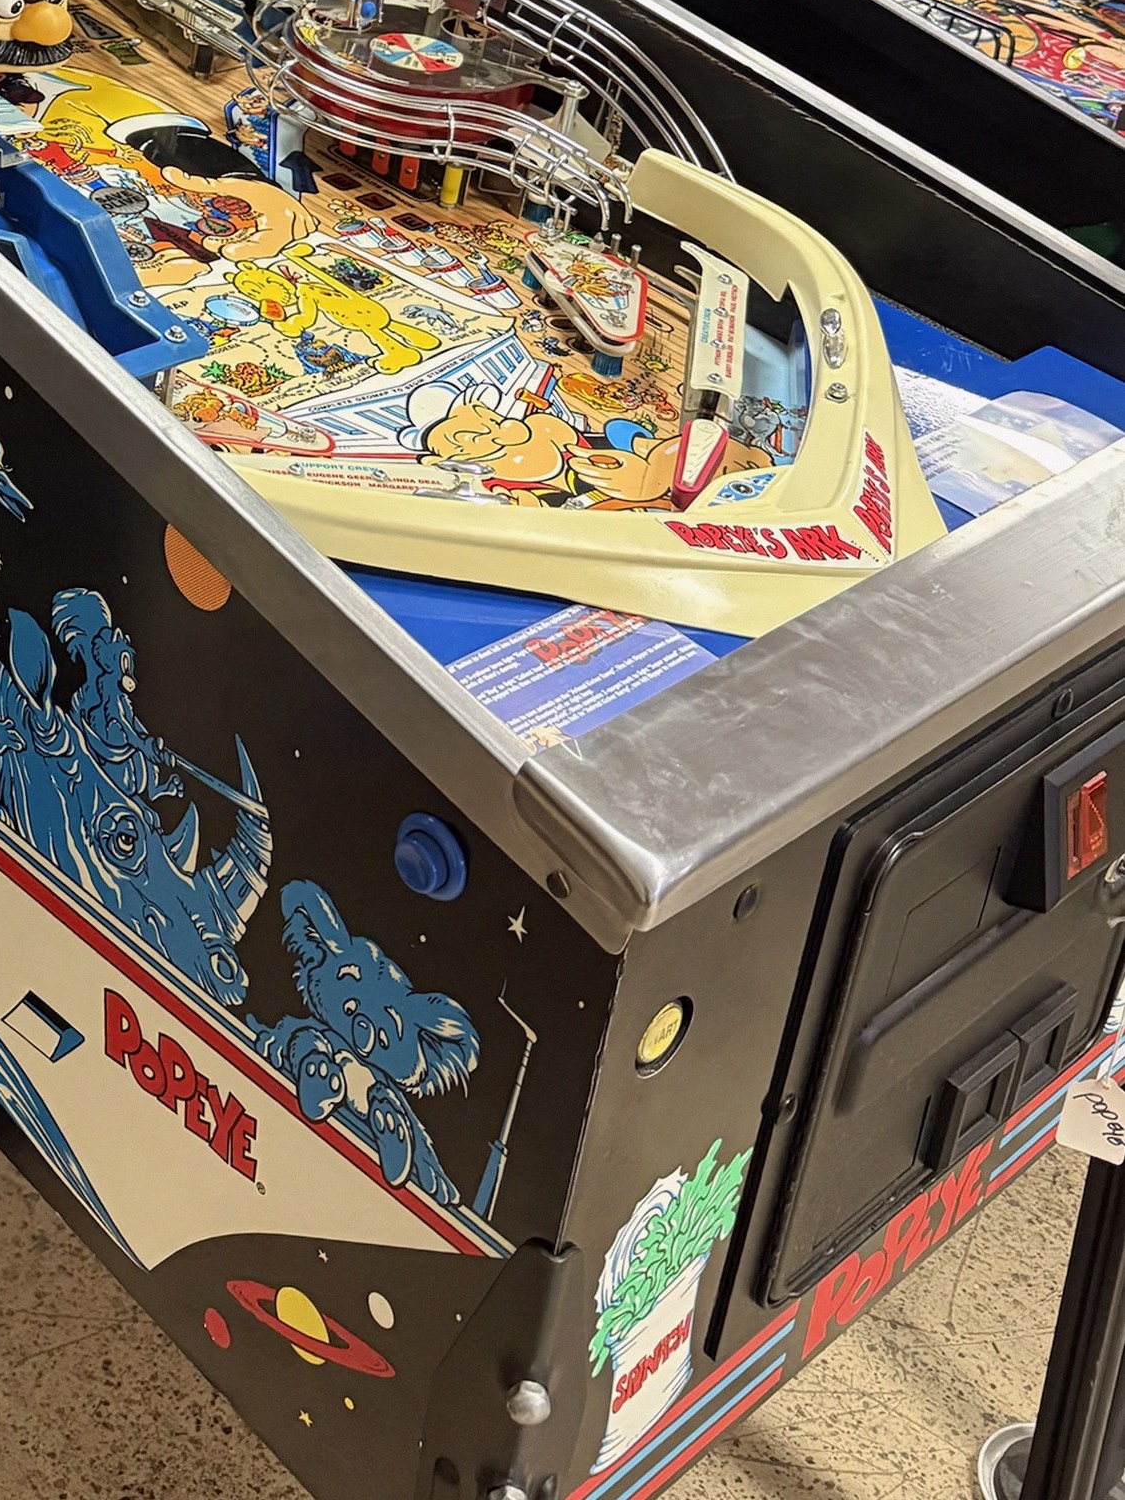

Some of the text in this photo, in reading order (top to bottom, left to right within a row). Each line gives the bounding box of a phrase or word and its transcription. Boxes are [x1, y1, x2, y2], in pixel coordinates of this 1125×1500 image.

[94, 189, 141, 211] SAVE OLIVE
[308, 397, 353, 412] COMPLETE
[301, 462, 344, 470] UPPORT
[664, 520, 788, 560] POPEYE'S
[780, 525, 863, 562] ARK
[104, 987, 258, 1182] POPEYE
[801, 1137, 994, 1361] POPEYE
[612, 1309, 693, 1414] SPINACH
